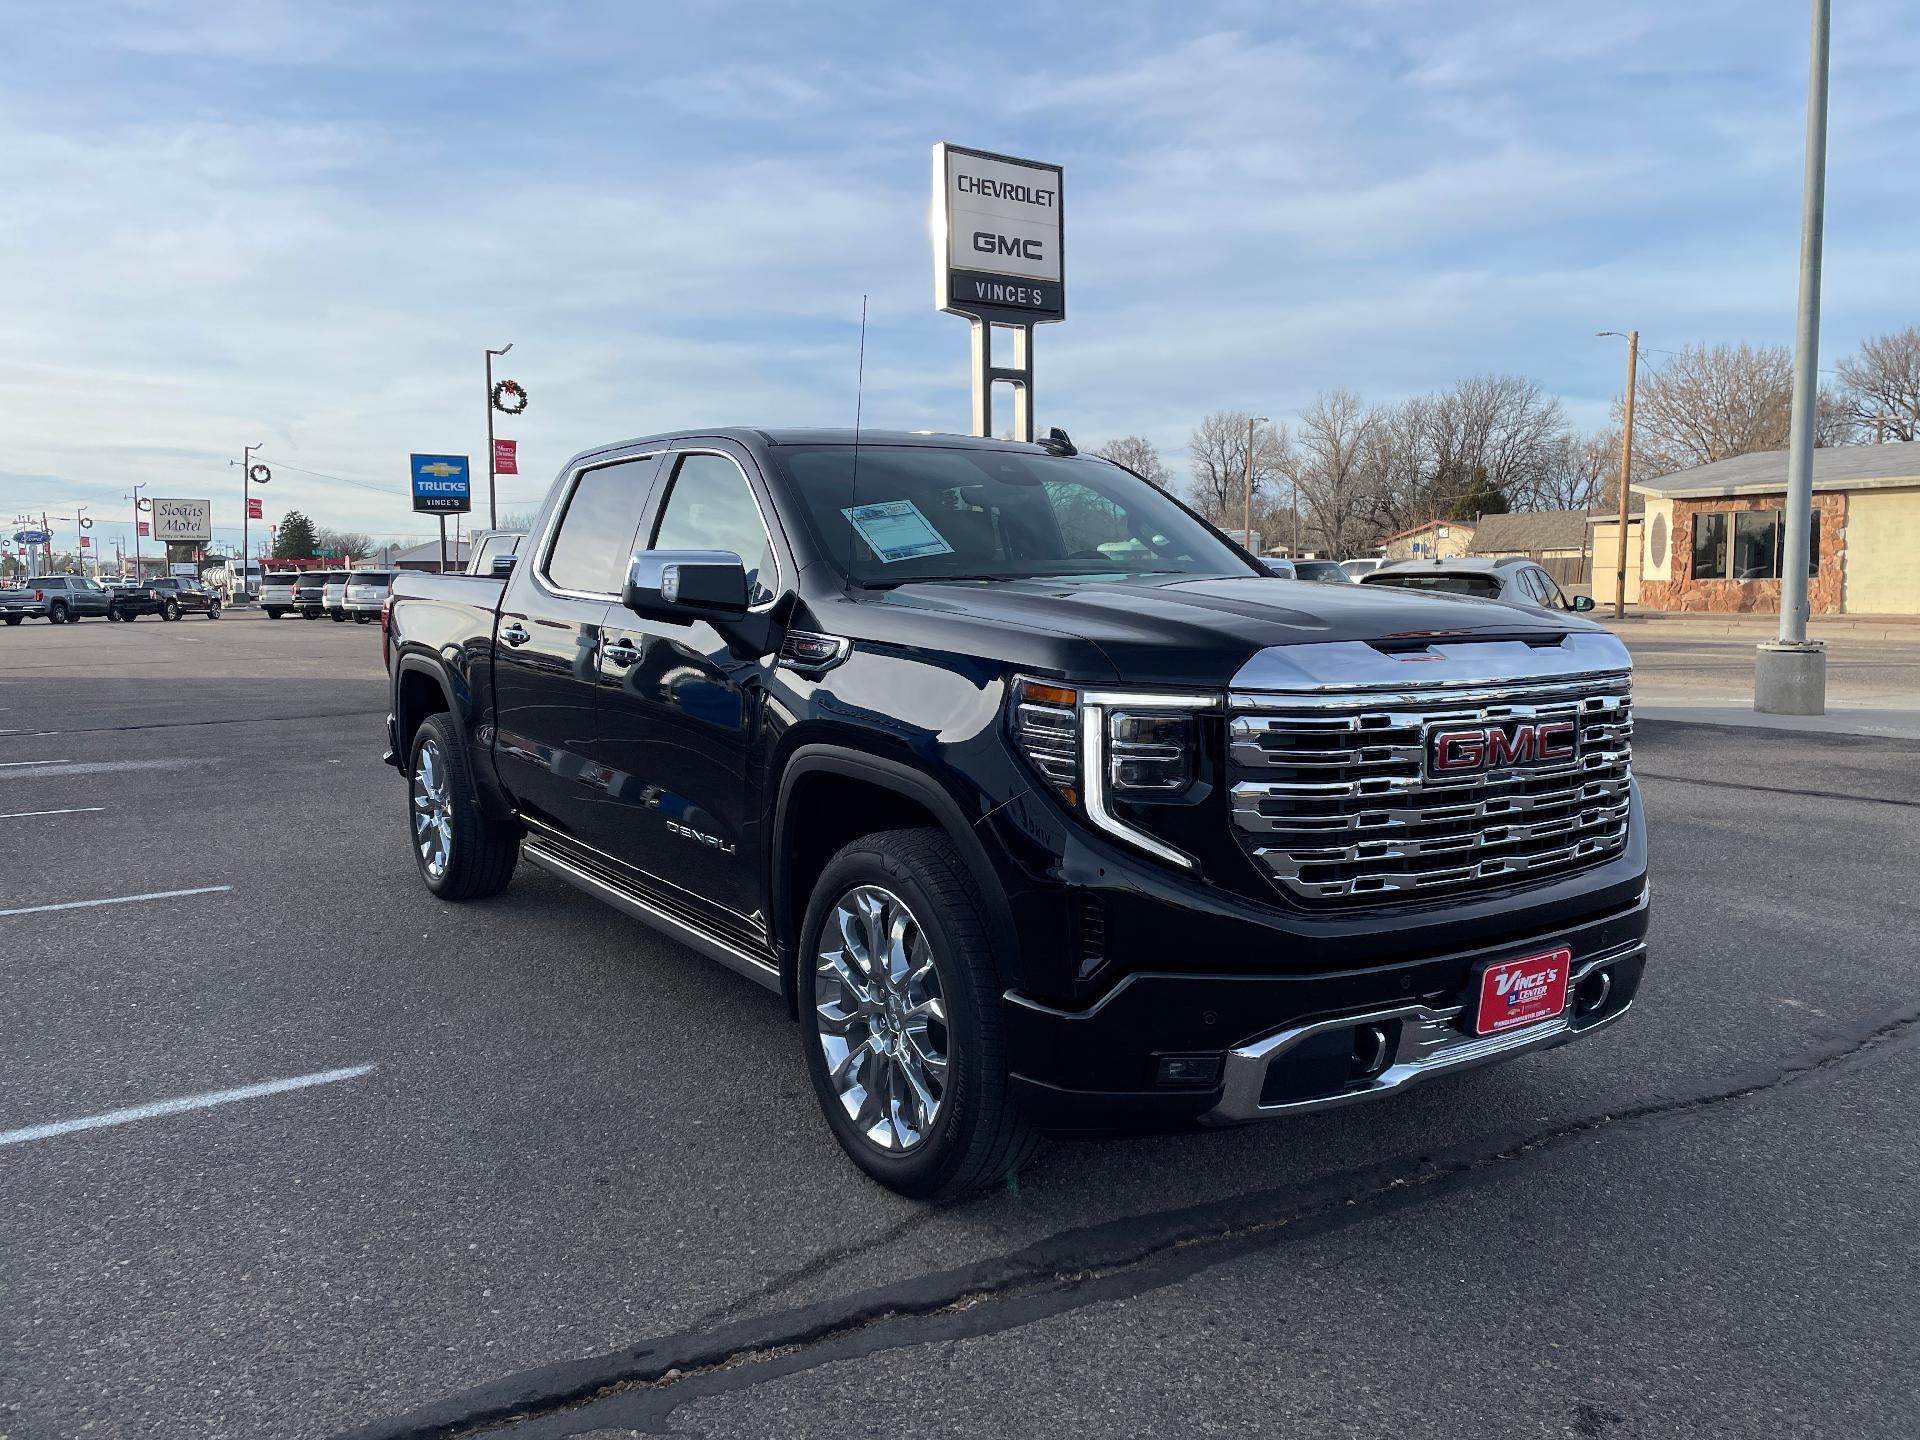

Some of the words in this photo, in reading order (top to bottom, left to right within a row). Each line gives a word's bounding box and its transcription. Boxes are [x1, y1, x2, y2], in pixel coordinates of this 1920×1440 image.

[957, 174, 1055, 207] CHEVROLET
[973, 231, 1043, 261] GMC
[975, 281, 1042, 306] VINCE'S
[417, 480, 466, 492] TRUCKS
[159, 501, 204, 517] Sloans
[426, 498, 460, 507] VINCE'S
[162, 518, 202, 532] Motel
[1434, 721, 1575, 771] GMC
[666, 820, 736, 855] DENALI
[1519, 985, 1548, 1000] CENTER
